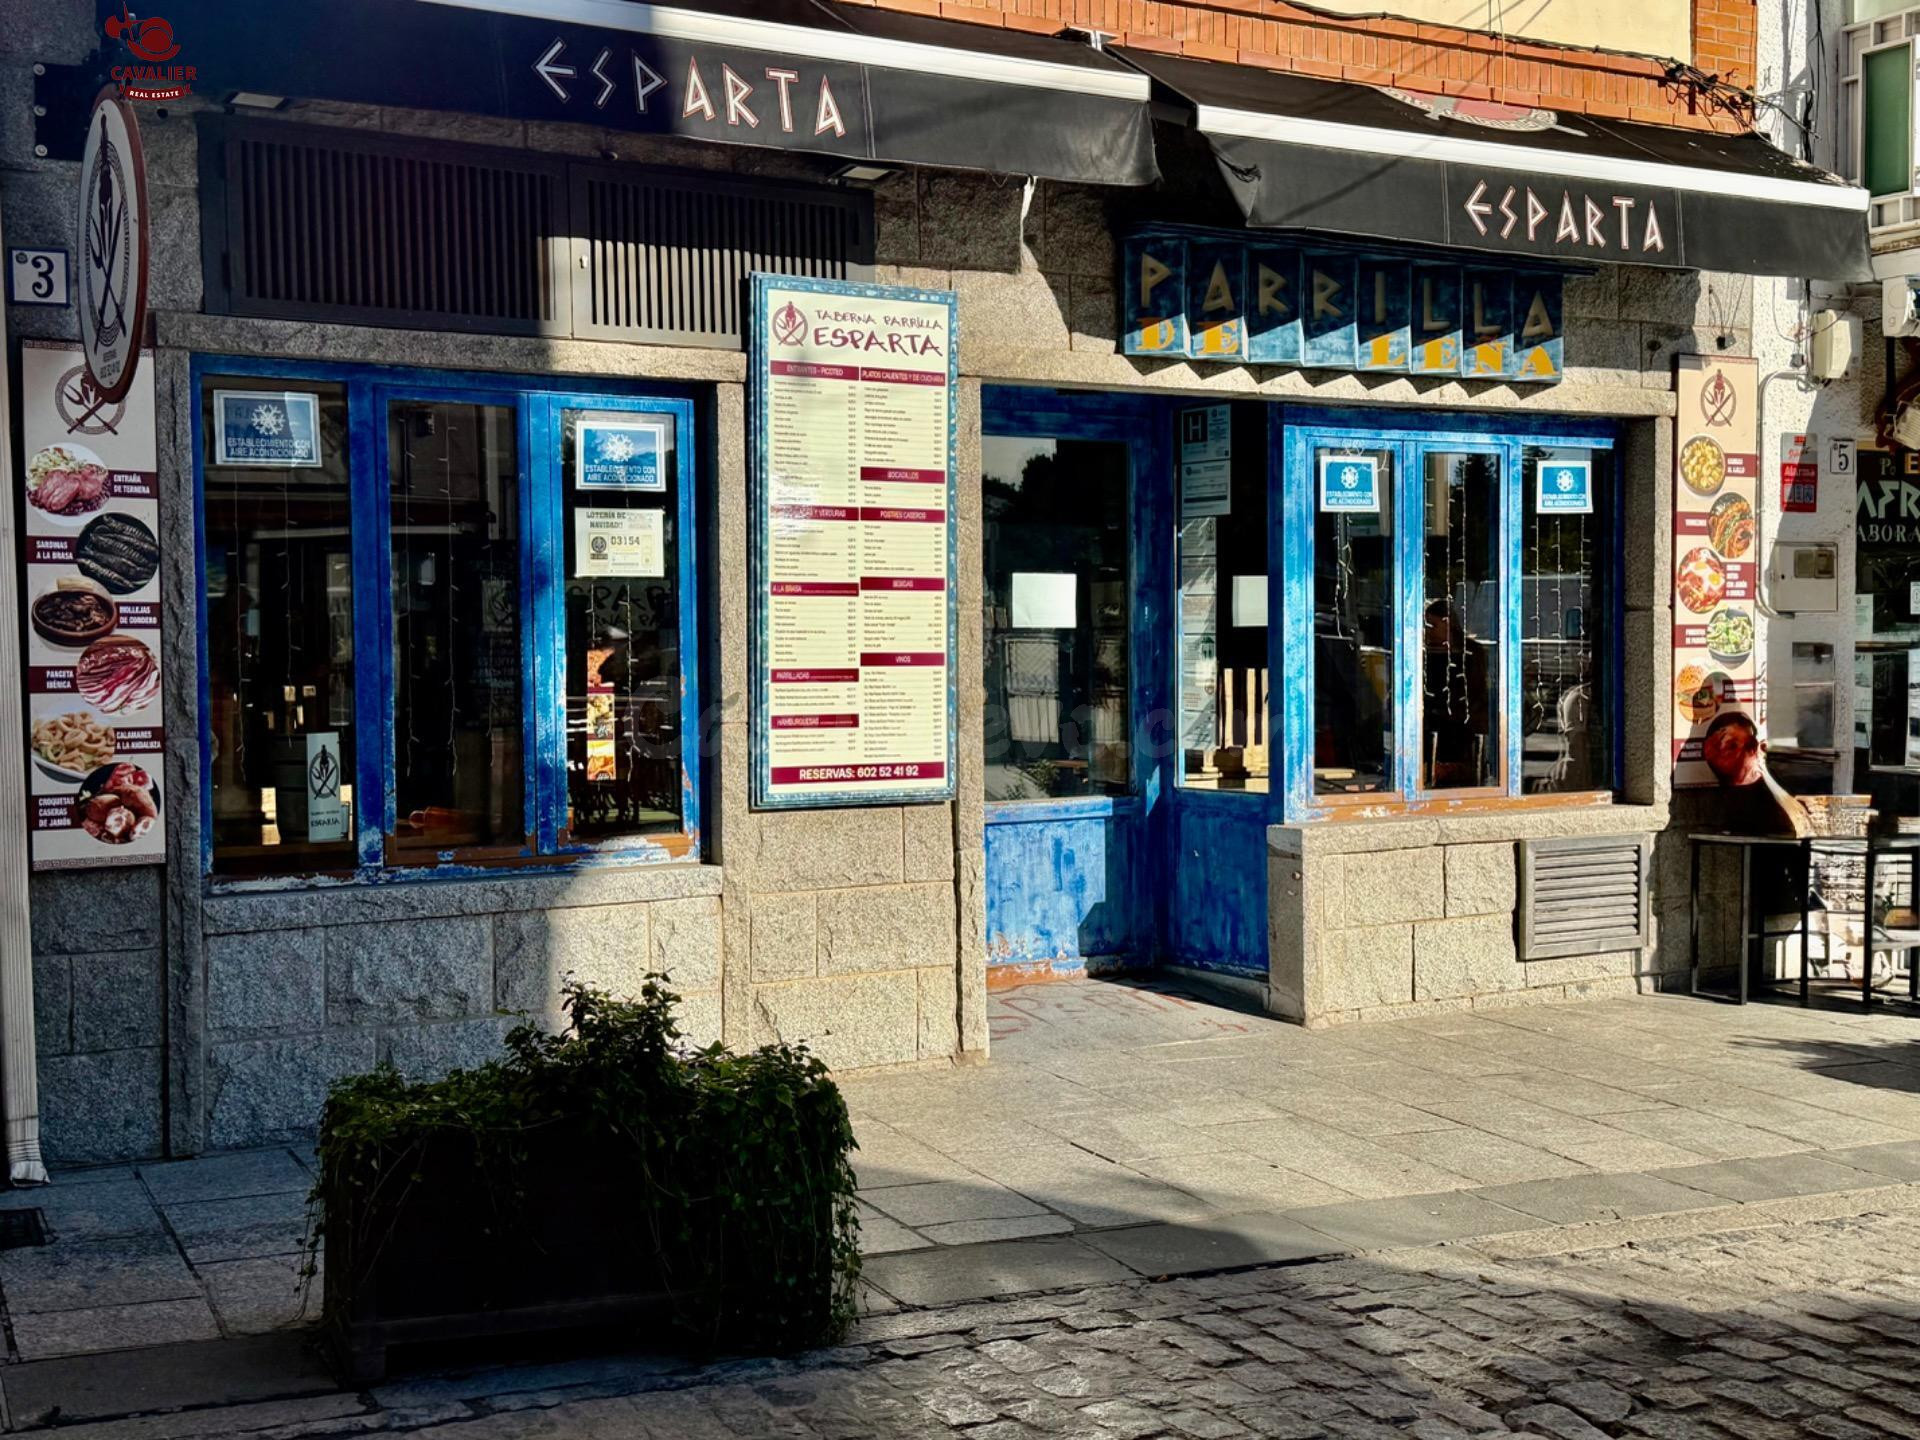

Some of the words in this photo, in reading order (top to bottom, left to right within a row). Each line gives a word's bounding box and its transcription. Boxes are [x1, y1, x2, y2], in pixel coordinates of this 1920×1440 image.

[531, 36, 846, 138] ESPARTA
[1464, 179, 1664, 253] ESPARTA
[31, 255, 54, 298] 3
[1141, 252, 1554, 338] PARRILLA
[816, 309, 877, 326] TABERNA
[883, 314, 944, 331] PARRILLA
[813, 326, 944, 358] ESPARTA
[1838, 444, 1849, 471] 5
[610, 535, 641, 546] 03154
[799, 767, 855, 780] RESERVAS:
[857, 766, 877, 778] 602
[879, 765, 892, 777] 52
[893, 765, 904, 777] 41
[905, 764, 919, 777] 92
